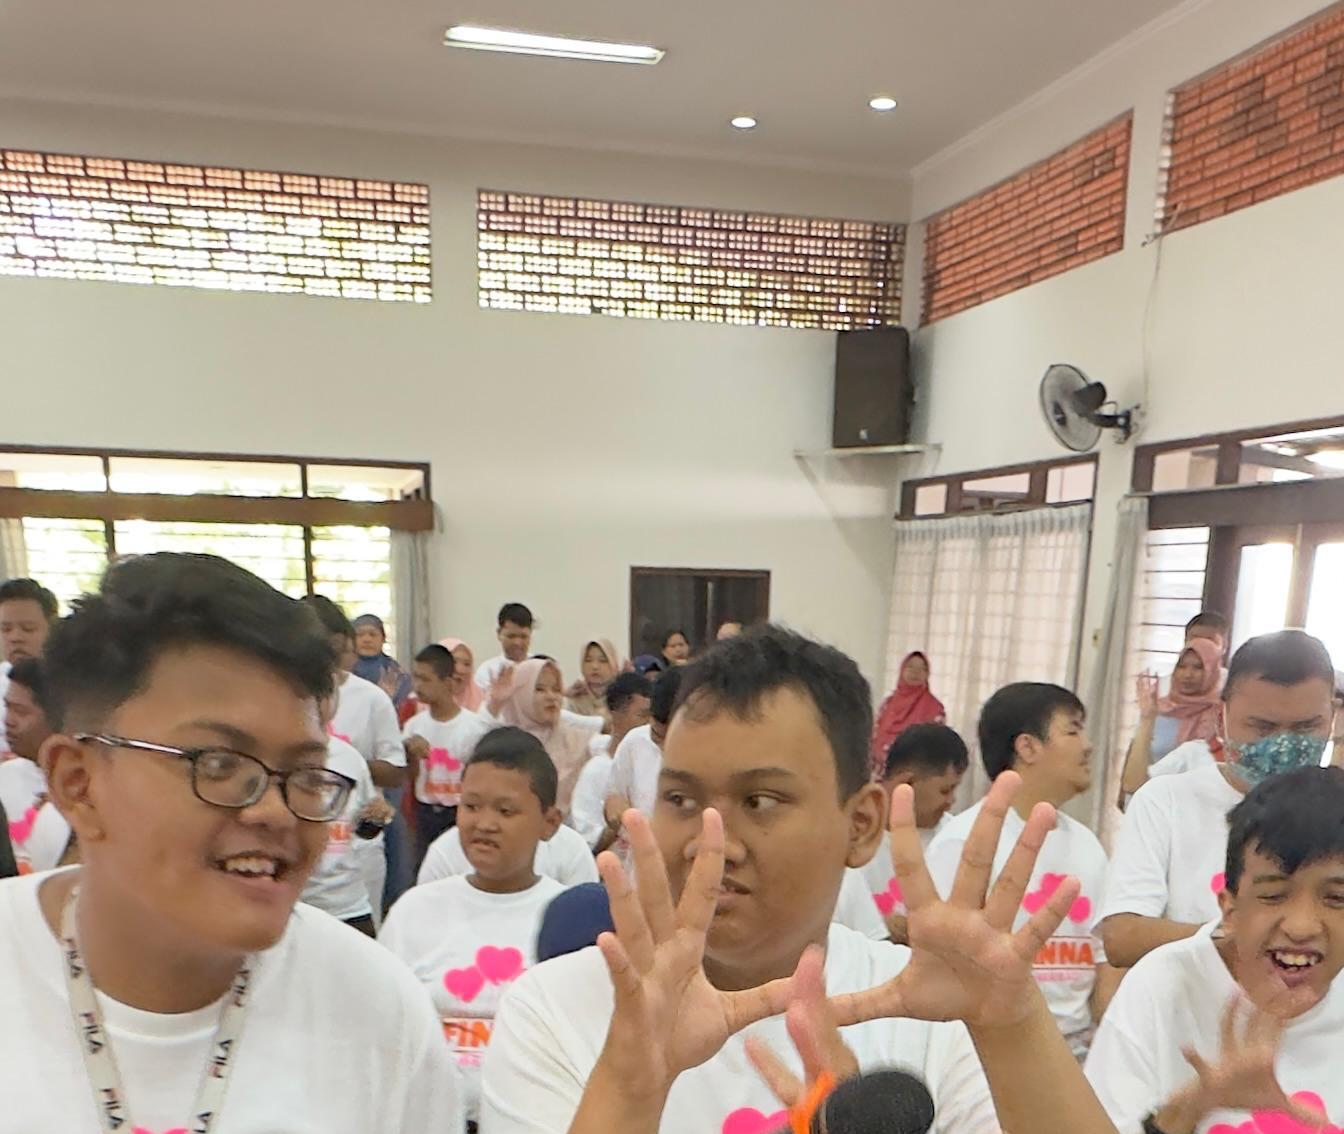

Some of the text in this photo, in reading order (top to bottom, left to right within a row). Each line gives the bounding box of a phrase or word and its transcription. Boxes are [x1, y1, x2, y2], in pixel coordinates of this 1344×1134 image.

[80, 1012, 103, 1054] FILA
[442, 1021, 490, 1047] FIN
[209, 1039, 233, 1078] FILA
[100, 1087, 125, 1129] FILA
